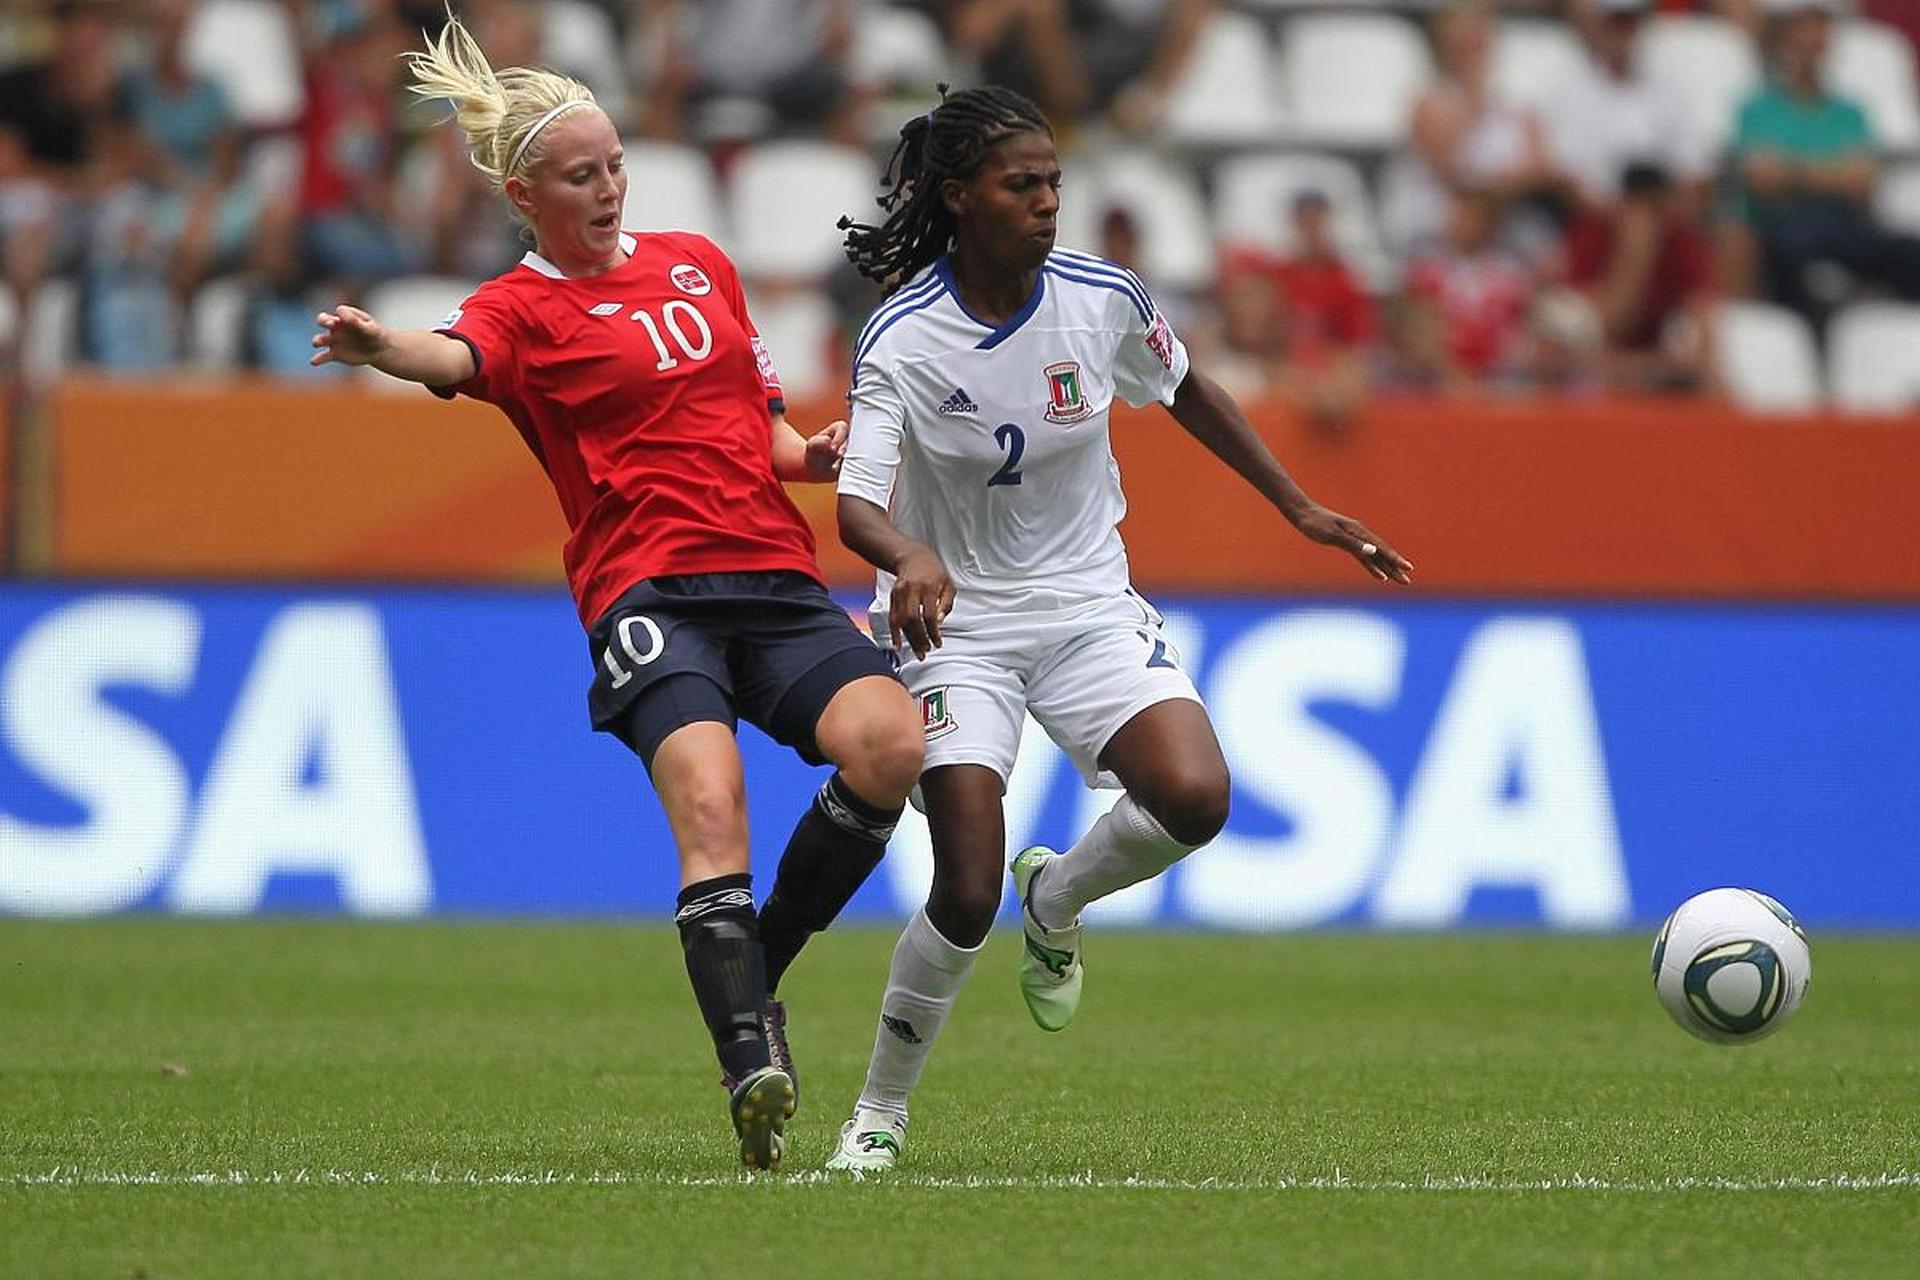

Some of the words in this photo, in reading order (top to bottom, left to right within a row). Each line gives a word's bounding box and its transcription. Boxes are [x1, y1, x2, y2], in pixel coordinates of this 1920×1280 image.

[630, 299, 712, 371] 10
[938, 401, 979, 413] adidas
[987, 423, 1025, 487] 2
[603, 615, 665, 689] 10
[878, 606, 1634, 929] SA
